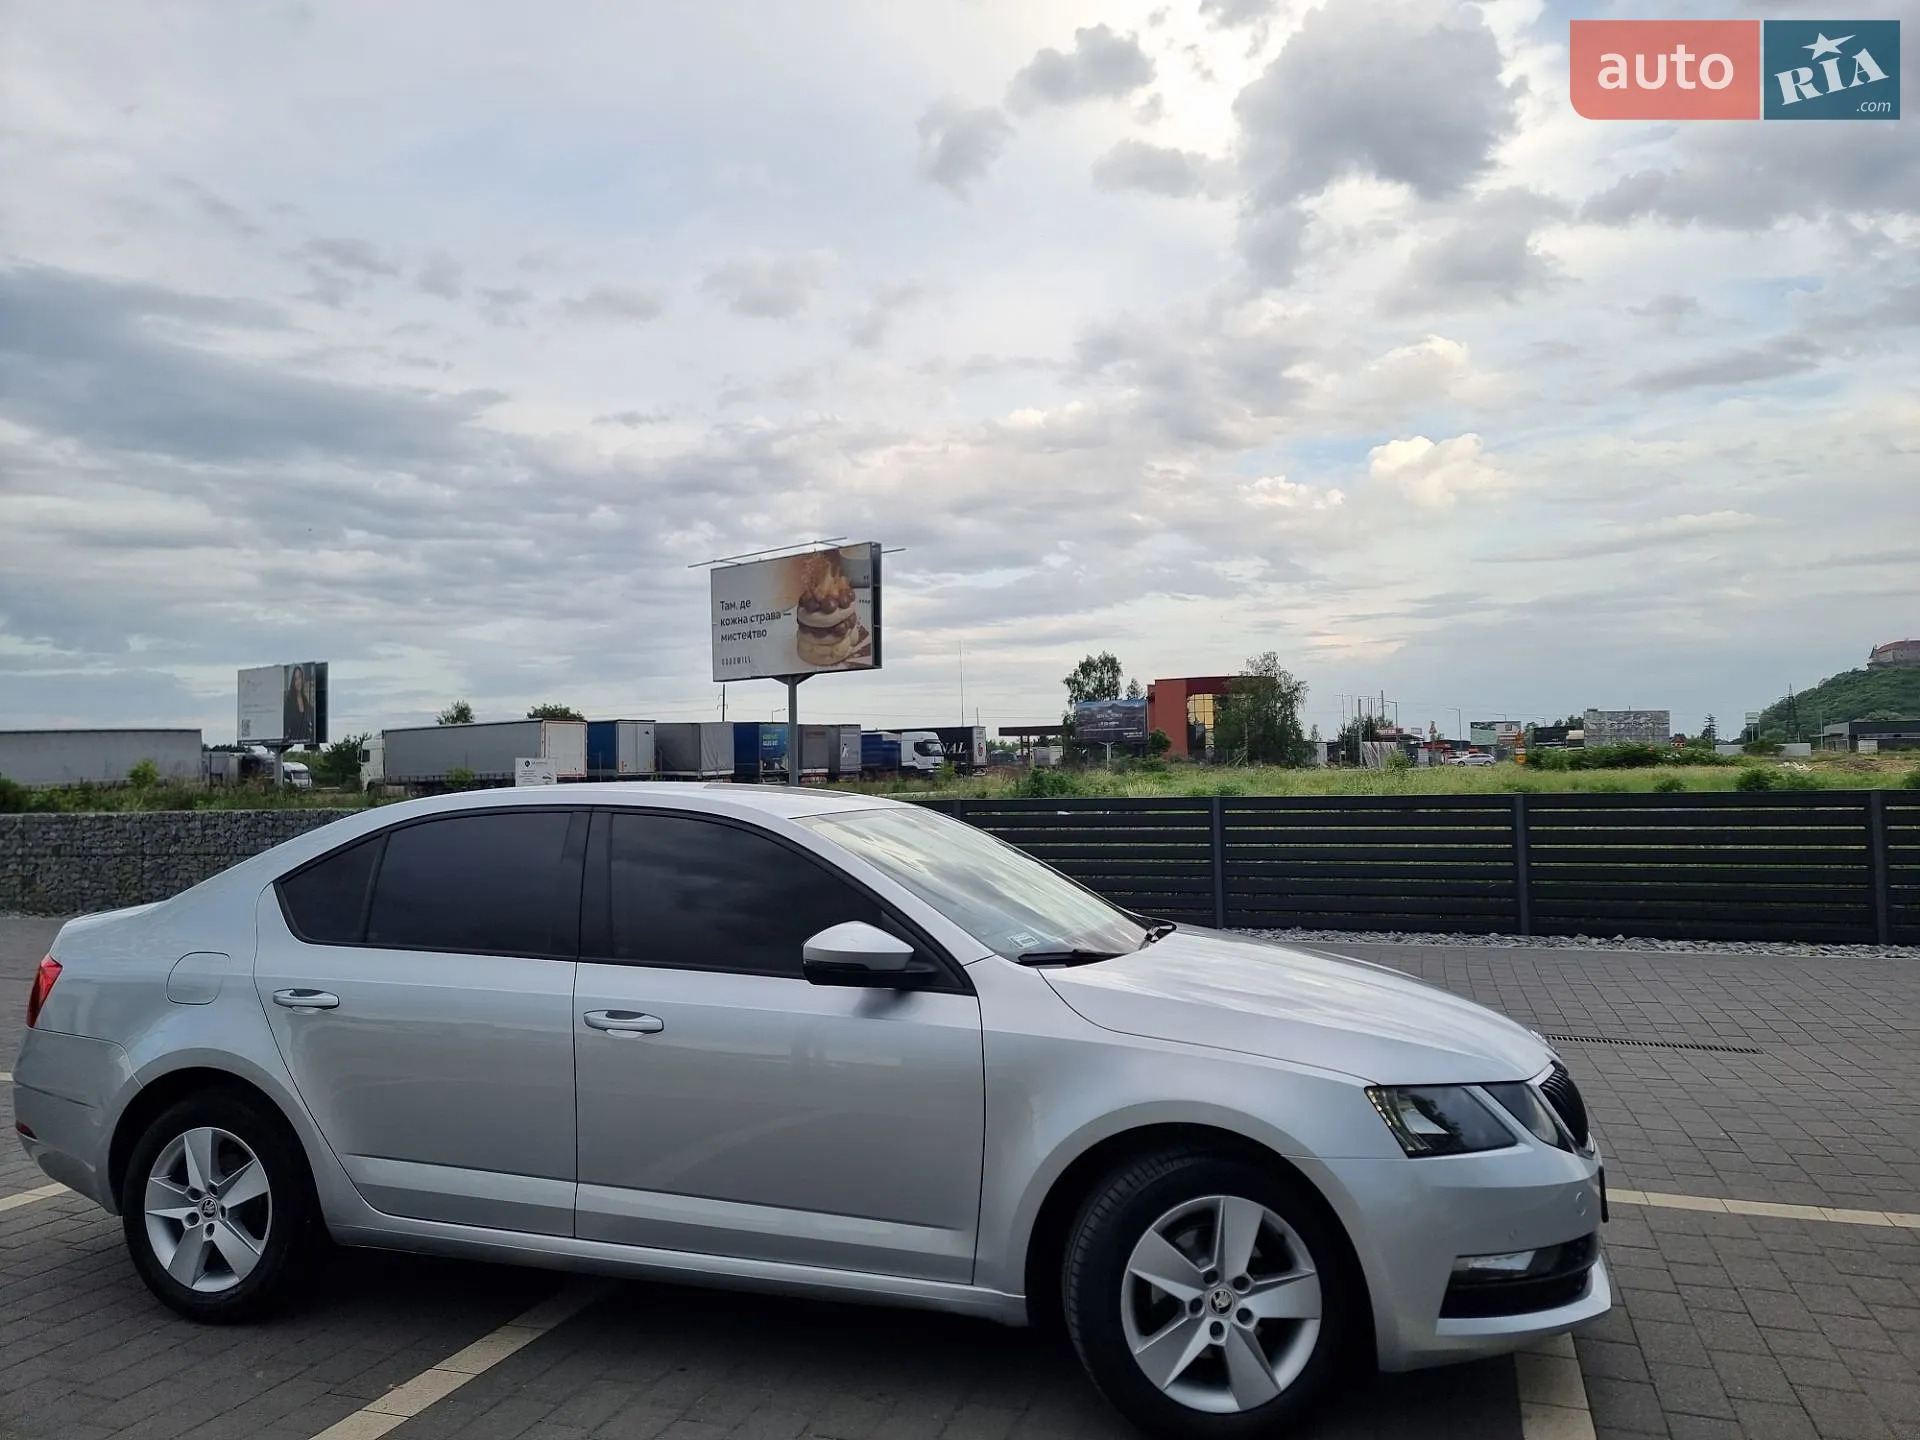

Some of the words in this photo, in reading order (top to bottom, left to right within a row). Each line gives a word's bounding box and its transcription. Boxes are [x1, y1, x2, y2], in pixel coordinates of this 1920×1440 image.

[740, 600, 751, 610] де
[720, 615, 748, 626] кожна
[750, 612, 781, 624] страва
[721, 629, 767, 642] мистецтво
